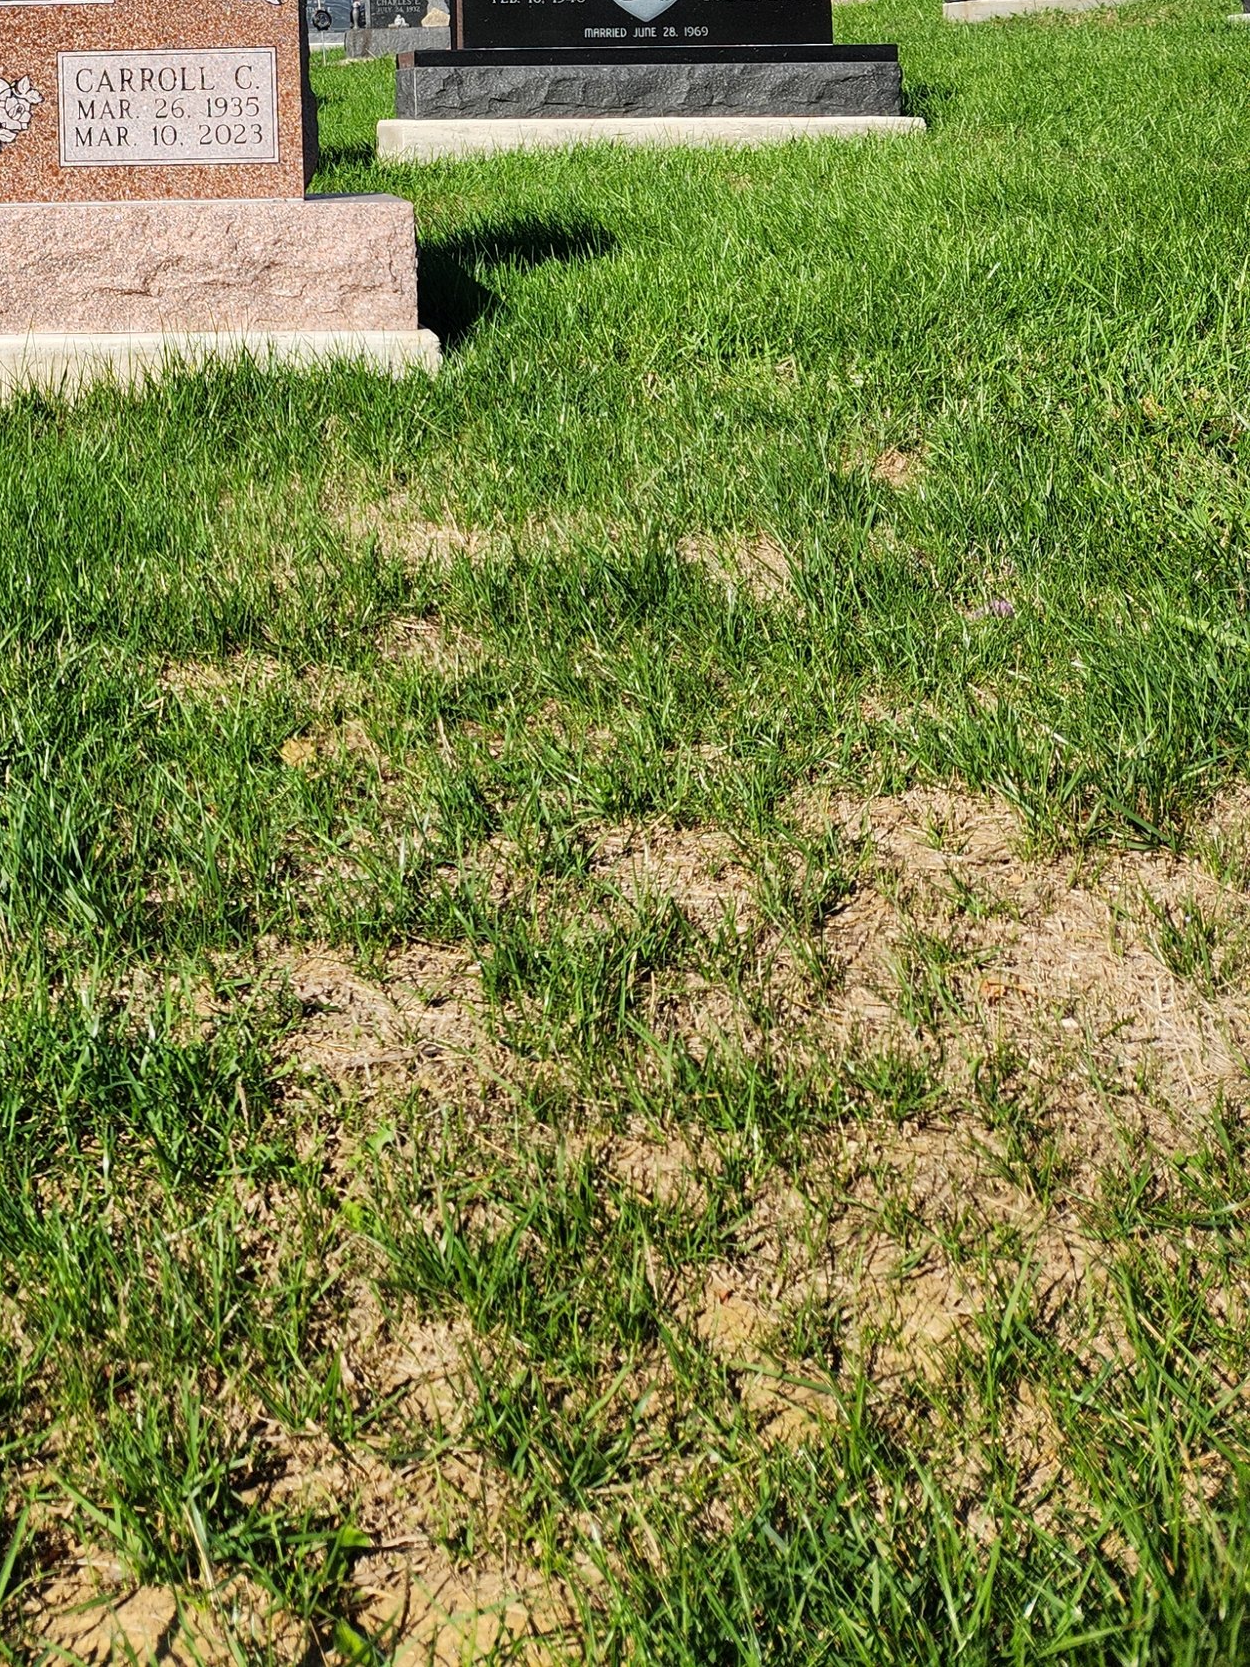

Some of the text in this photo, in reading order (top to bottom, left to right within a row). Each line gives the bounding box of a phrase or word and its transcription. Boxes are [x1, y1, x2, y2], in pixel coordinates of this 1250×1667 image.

[584, 27, 627, 38] MARRIED
[633, 27, 657, 38] JUNE
[684, 26, 709, 37] 1969
[75, 65, 260, 92] CARROLL C.
[77, 98, 140, 120] MAR.
[206, 97, 260, 118] 1935
[75, 125, 137, 147] MAR.
[199, 123, 263, 145] 2023
